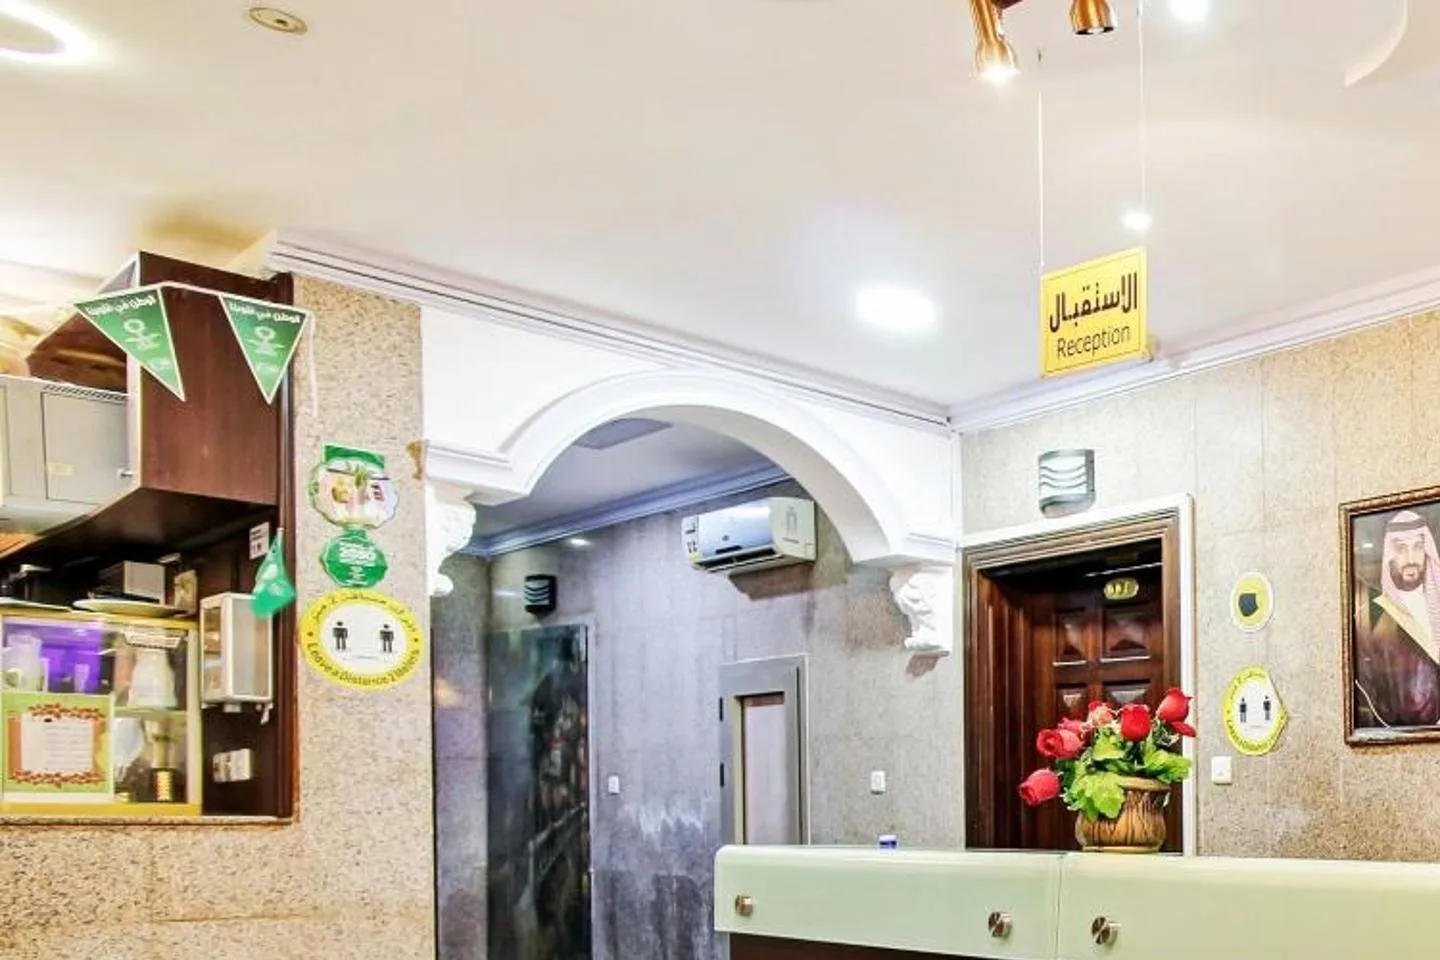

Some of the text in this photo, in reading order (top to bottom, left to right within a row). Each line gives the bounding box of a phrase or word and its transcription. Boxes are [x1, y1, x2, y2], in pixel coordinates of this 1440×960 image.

[1057, 325, 1131, 359] Reception
[307, 642, 333, 673] Leave
[339, 671, 388, 686] Distance
